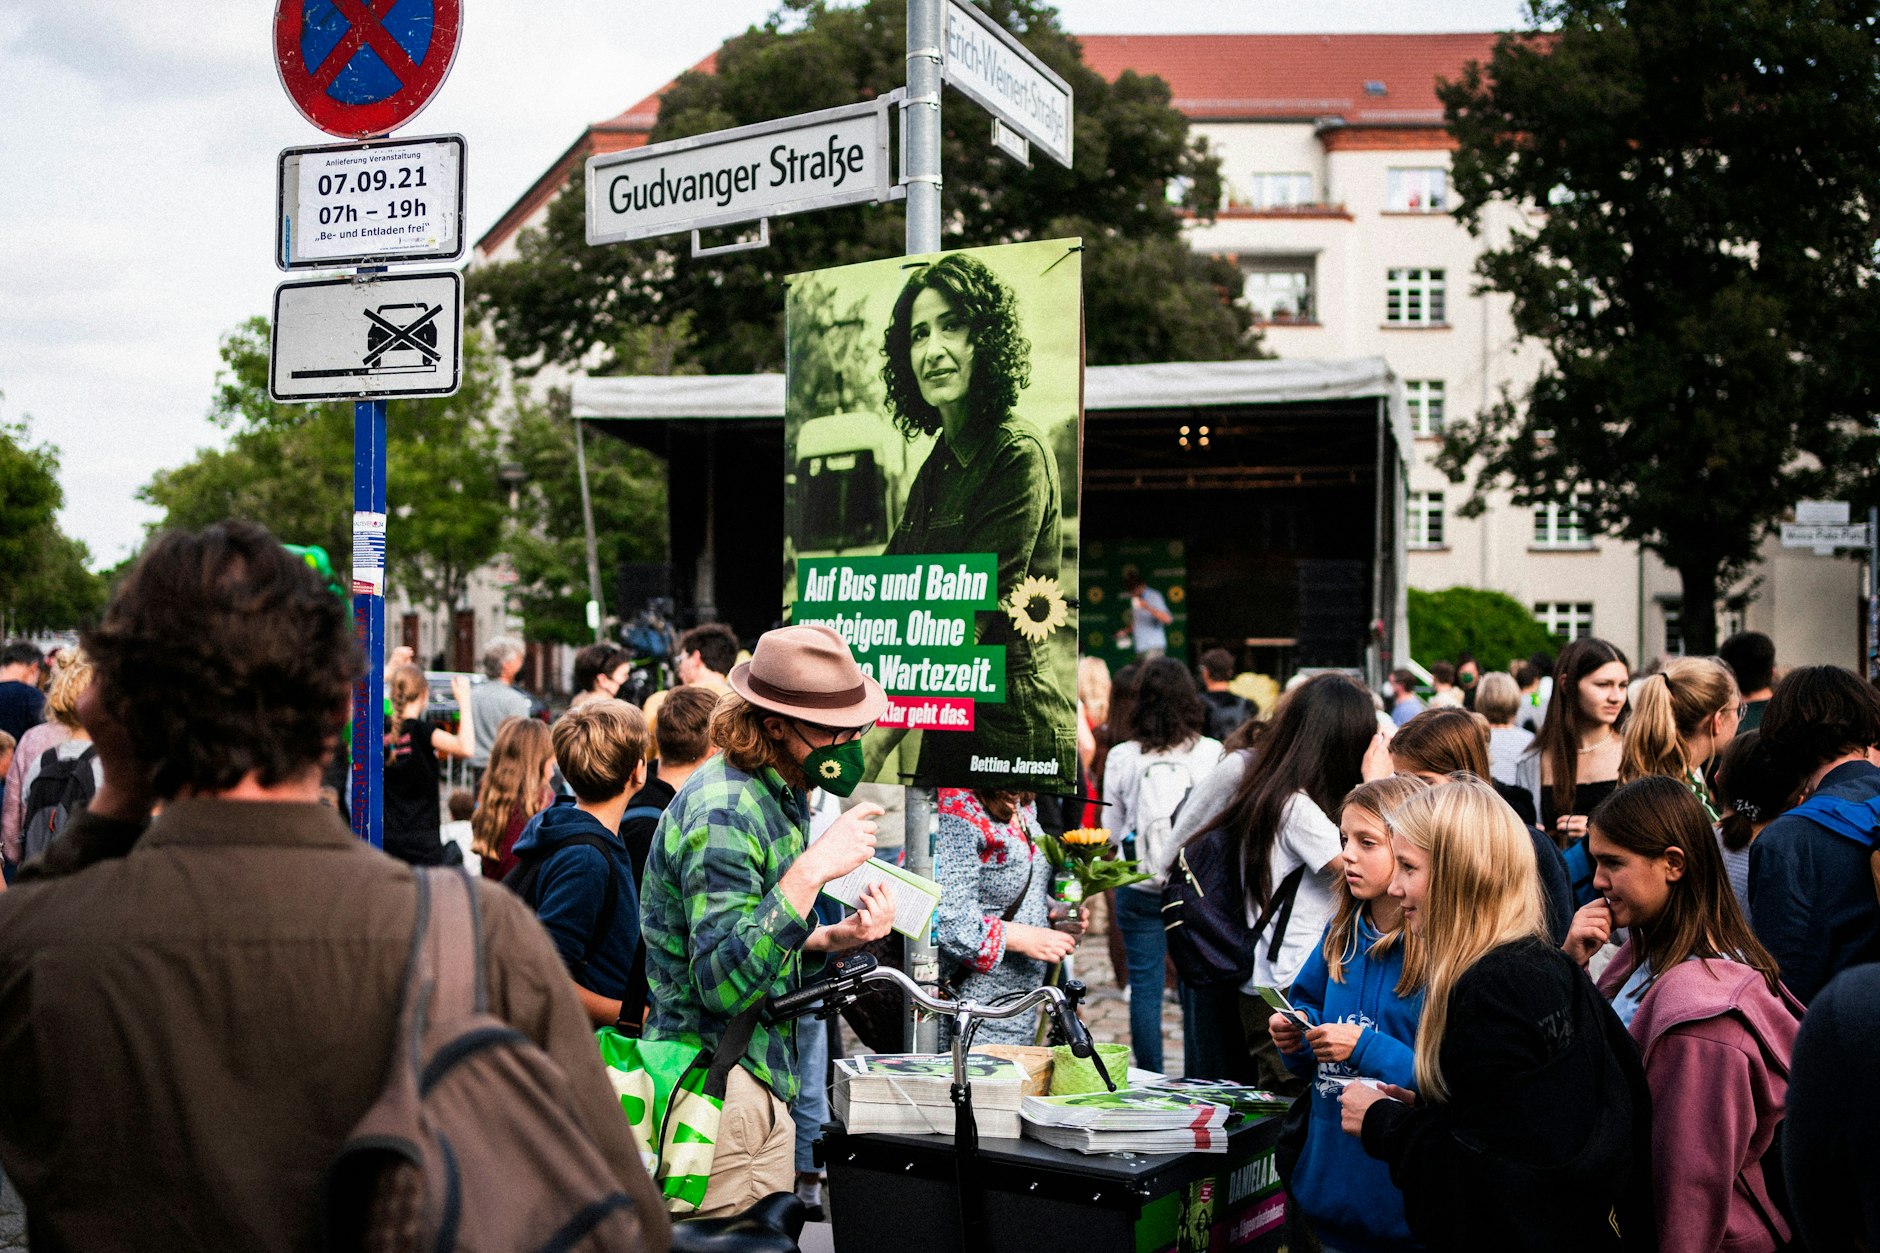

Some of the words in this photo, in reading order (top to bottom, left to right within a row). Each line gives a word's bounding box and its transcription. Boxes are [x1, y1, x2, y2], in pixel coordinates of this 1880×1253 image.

[948, 14, 1064, 142] Erich-Weinert-Straße
[326, 156, 367, 167] Anlieferung
[369, 151, 421, 163] Veranstaltung
[609, 162, 760, 214] Gudvanger
[769, 134, 864, 188] Straße
[318, 166, 427, 196] 07.09.21
[319, 204, 357, 225] 07h
[387, 198, 426, 219] 19h
[340, 228, 358, 239] und
[361, 225, 405, 238] Entladen
[804, 567, 838, 602] Auf
[838, 566, 877, 602] Bus
[880, 564, 923, 602] und
[925, 563, 989, 601] Bahn
[799, 612, 903, 653] teigen.
[906, 610, 966, 647] Ohne
[878, 654, 996, 693] Wartezeit.
[880, 701, 907, 723] Klar
[907, 702, 938, 728] geht
[939, 702, 970, 726] das.
[970, 755, 1011, 774] Bettina
[1012, 756, 1059, 775] Jarasch
[1228, 1156, 1268, 1205] DANIELA
